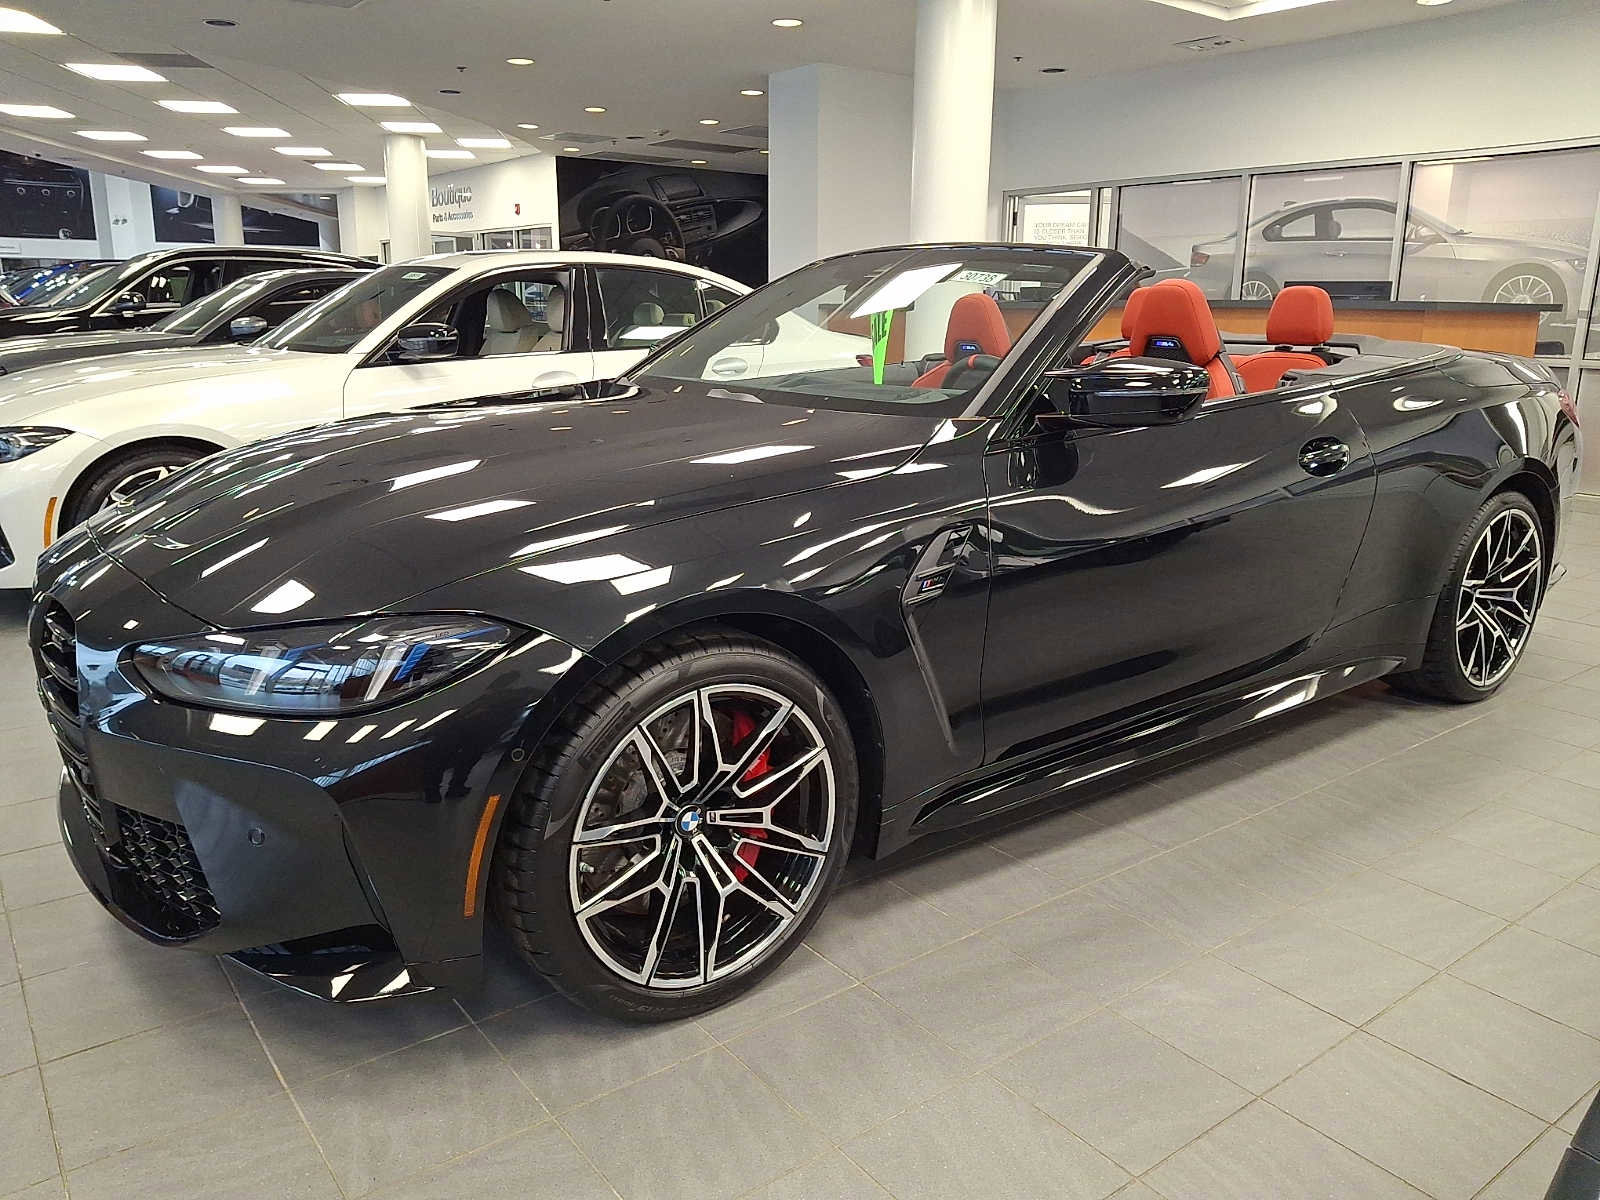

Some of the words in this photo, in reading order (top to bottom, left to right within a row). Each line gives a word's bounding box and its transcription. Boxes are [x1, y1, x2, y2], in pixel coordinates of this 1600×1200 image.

[432, 186, 473, 208] Boutique
[433, 213, 443, 223] Parts
[448, 211, 474, 221] Accessories
